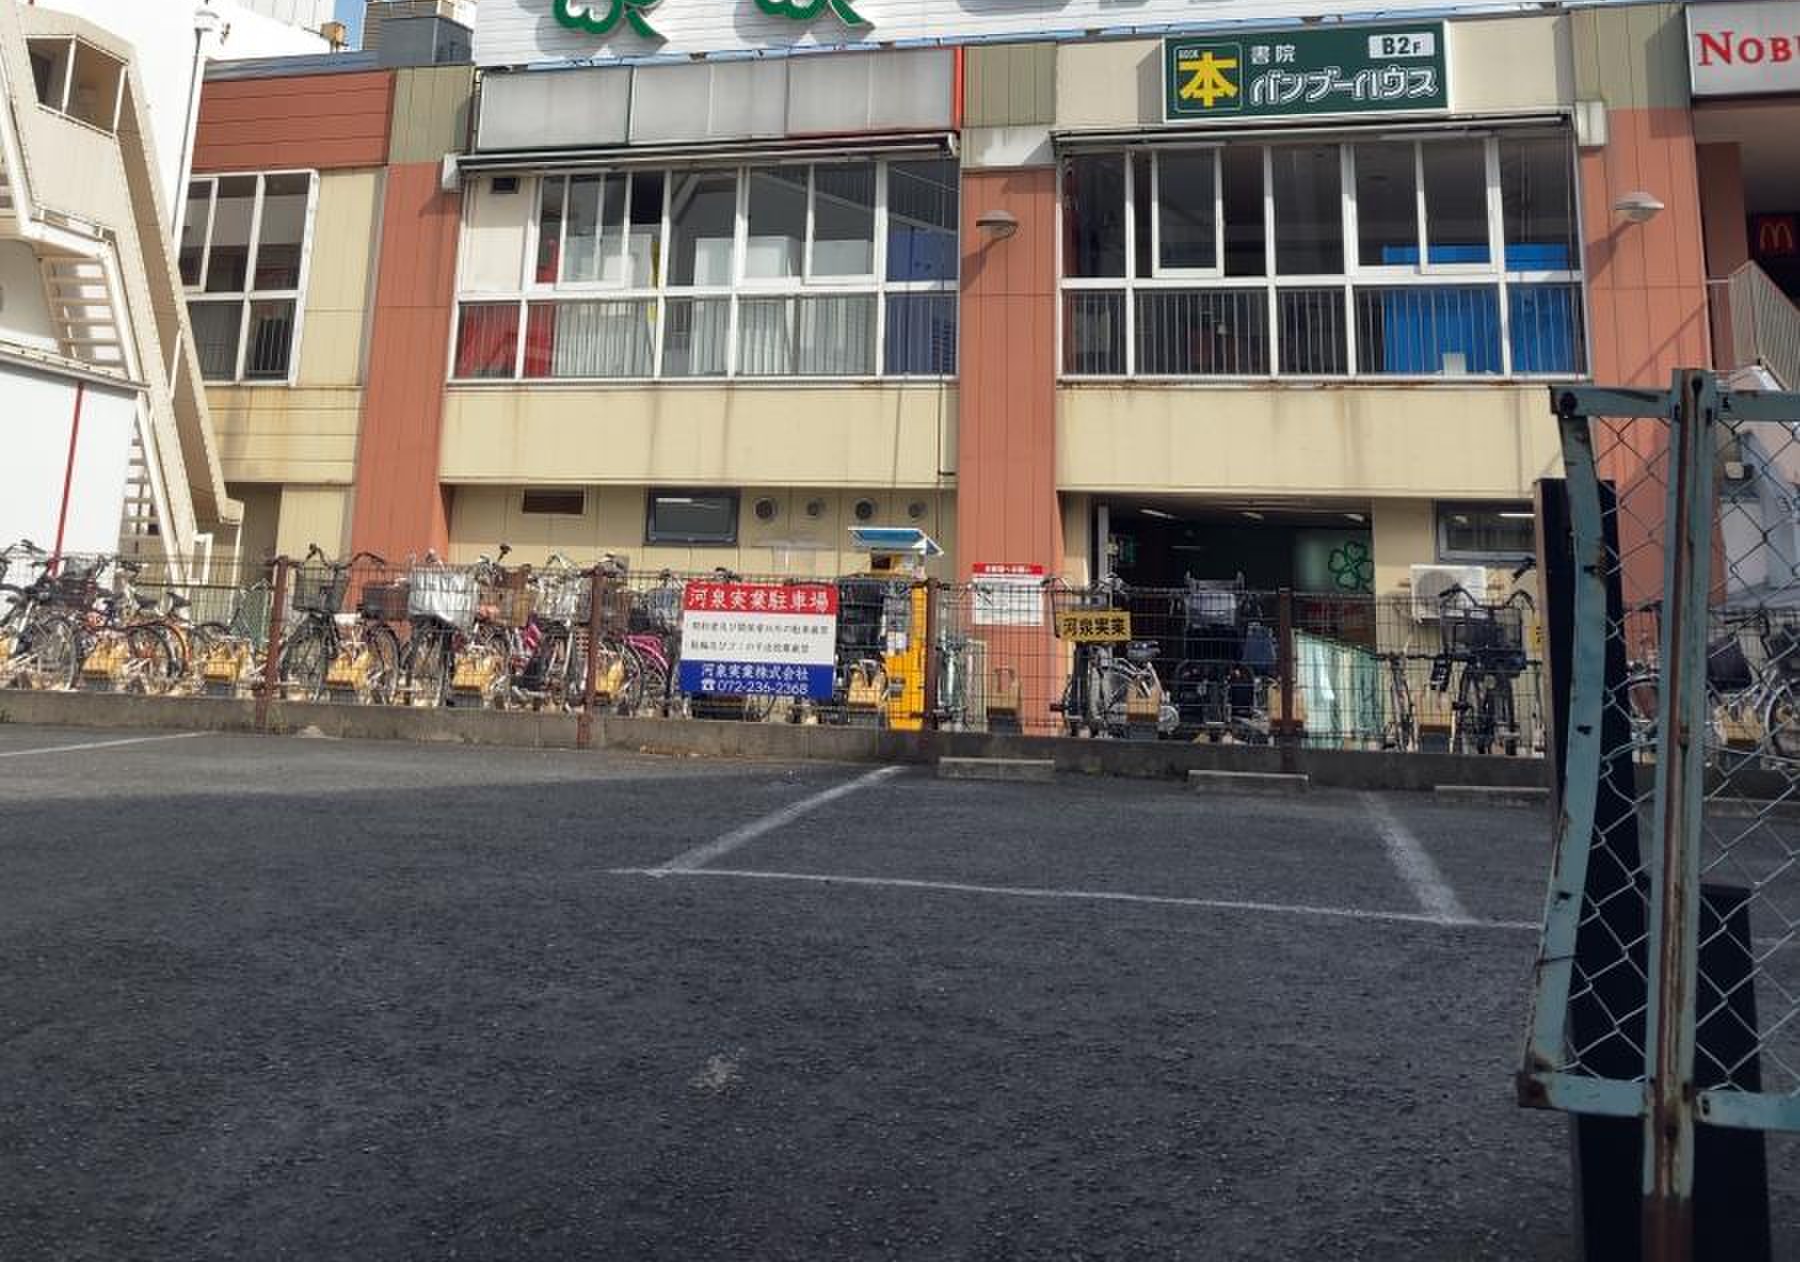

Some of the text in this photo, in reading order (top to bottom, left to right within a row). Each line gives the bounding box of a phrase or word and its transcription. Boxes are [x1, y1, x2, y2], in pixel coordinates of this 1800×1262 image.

[1251, 45, 1296, 65] 書院
[1382, 37, 1421, 55] B2F
[1696, 31, 1800, 66] NOB
[1178, 51, 1239, 108] 本
